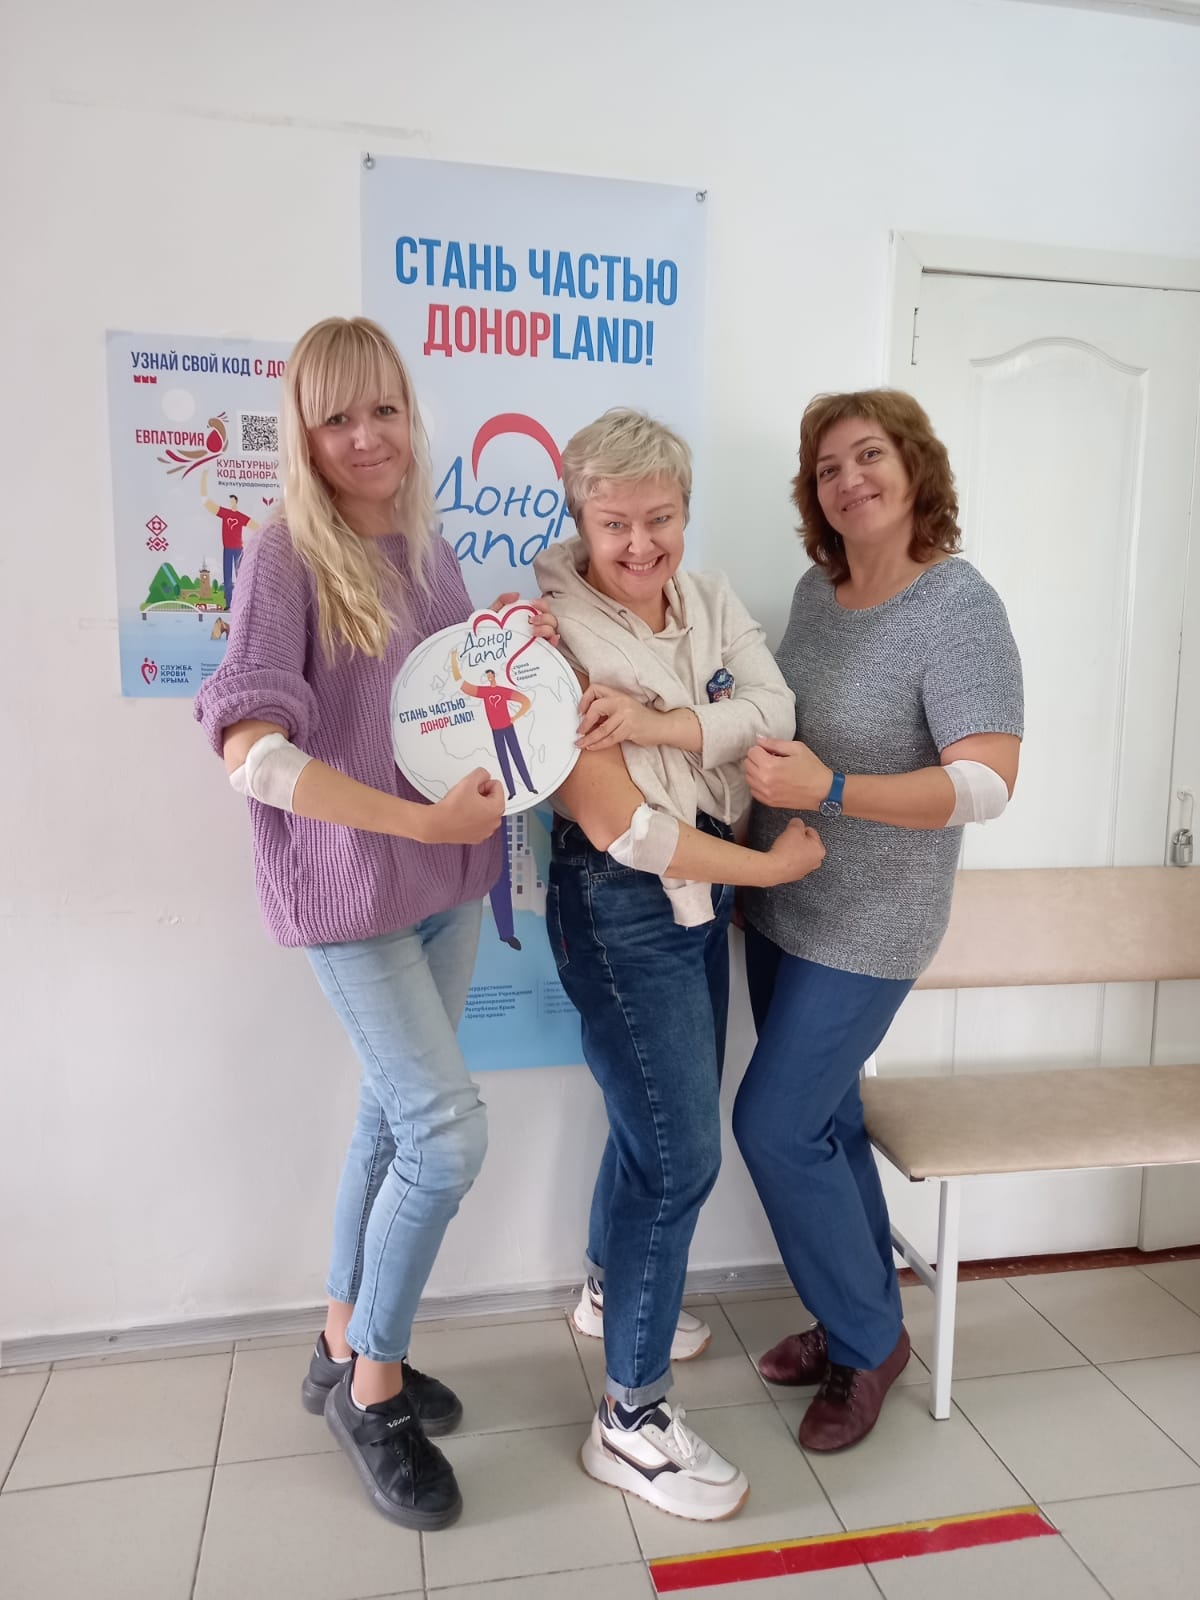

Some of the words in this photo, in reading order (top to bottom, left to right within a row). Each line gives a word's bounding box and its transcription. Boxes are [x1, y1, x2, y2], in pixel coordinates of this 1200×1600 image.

[395, 236, 517, 293] СТАНЬ
[528, 248, 679, 306] ЧАСТЬЮ
[423, 303, 654, 366] ДОНОРLAND!
[131, 350, 179, 371] УЗНАЙ
[182, 353, 219, 373] СВОЙ
[222, 357, 251, 376] КОД
[254, 359, 263, 375] С
[266, 360, 286, 378] ДО
[135, 429, 205, 447] ЕВПАТОРИЯ
[216, 458, 280, 470] КУЛЬТУРНЫЙ
[216, 469, 237, 480] КОД
[239, 470, 278, 480] ДОНОРА
[439, 518, 556, 568] and
[460, 630, 513, 658] Донор
[468, 642, 507, 668] Land
[398, 707, 428, 724] СТАНЬ
[429, 697, 466, 716] ЧАСТЬЮ
[420, 710, 476, 735] ДОНОРLAND!
